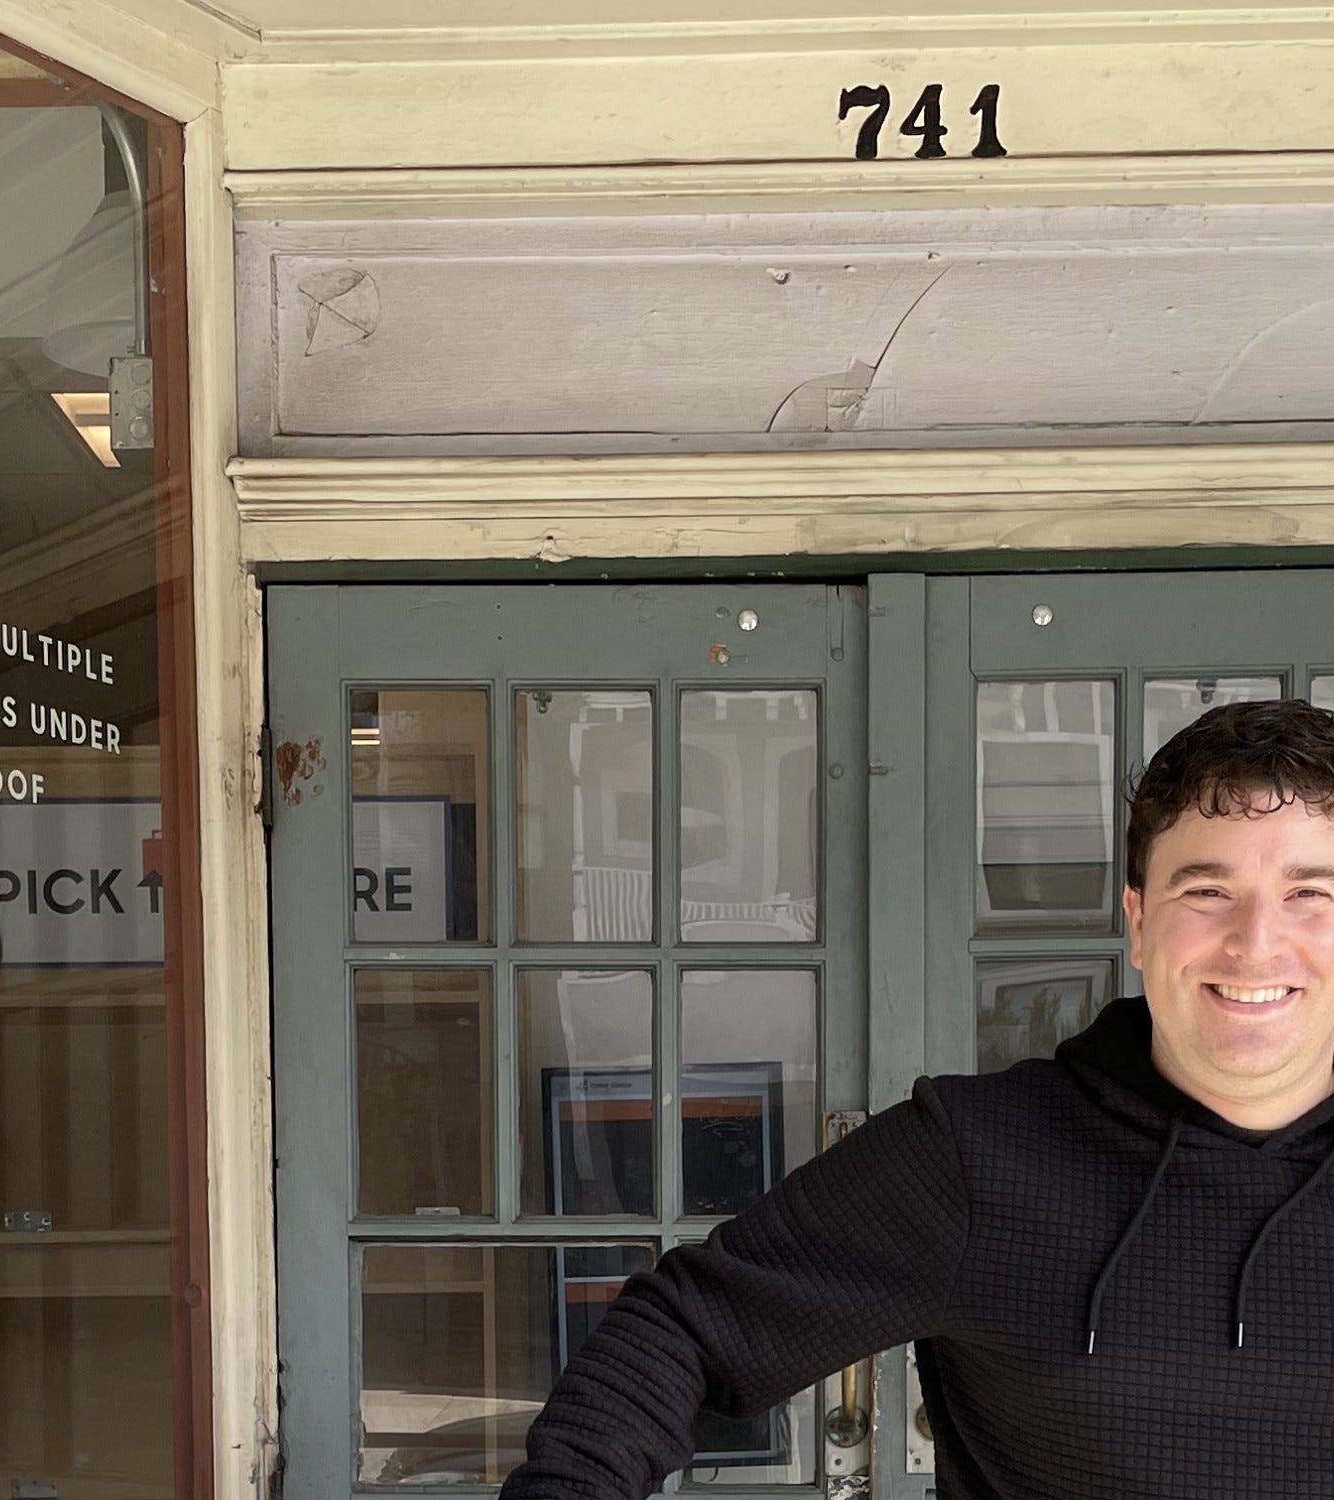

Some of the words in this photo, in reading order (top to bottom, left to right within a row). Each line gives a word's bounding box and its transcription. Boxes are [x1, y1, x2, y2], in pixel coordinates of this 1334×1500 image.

[837, 84, 1009, 161] 741
[29, 702, 122, 755] UNDER
[353, 866, 413, 913] RE
